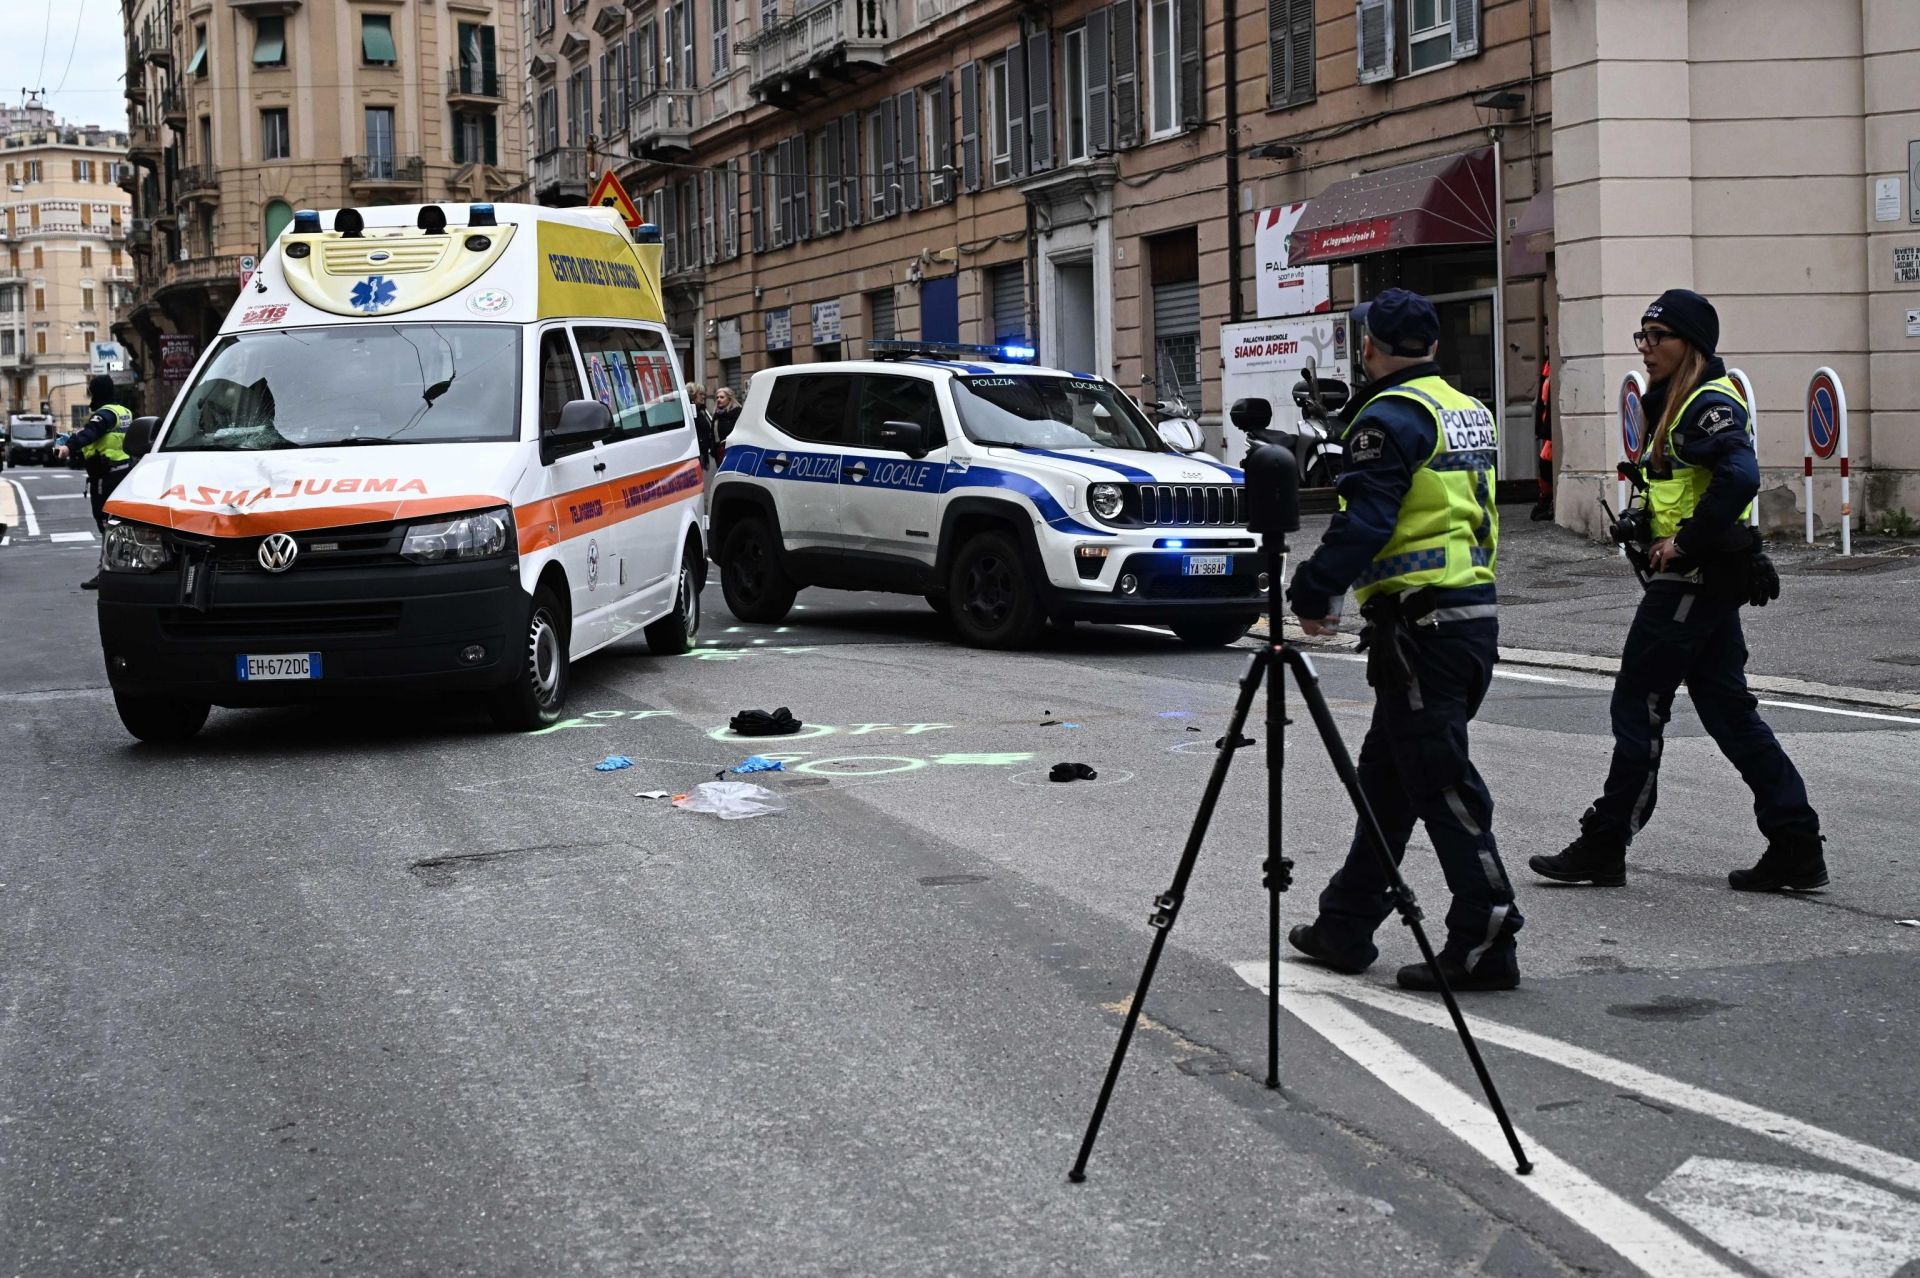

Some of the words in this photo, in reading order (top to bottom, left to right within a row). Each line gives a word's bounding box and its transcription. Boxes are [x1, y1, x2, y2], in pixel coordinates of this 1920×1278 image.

[1243, 335, 1265, 344] PALAGYM
[1265, 333, 1289, 342] BRIGNOLE
[1234, 344, 1264, 358] SIAMO
[1265, 341, 1298, 356] APERTI
[971, 378, 1016, 388] POLIZIA
[1069, 381, 1106, 392] LOCALE
[1442, 409, 1493, 429] POLIZIA
[1447, 429, 1498, 450] LOCALE
[788, 456, 840, 479] POLIZIA
[872, 462, 931, 488] LOCALE
